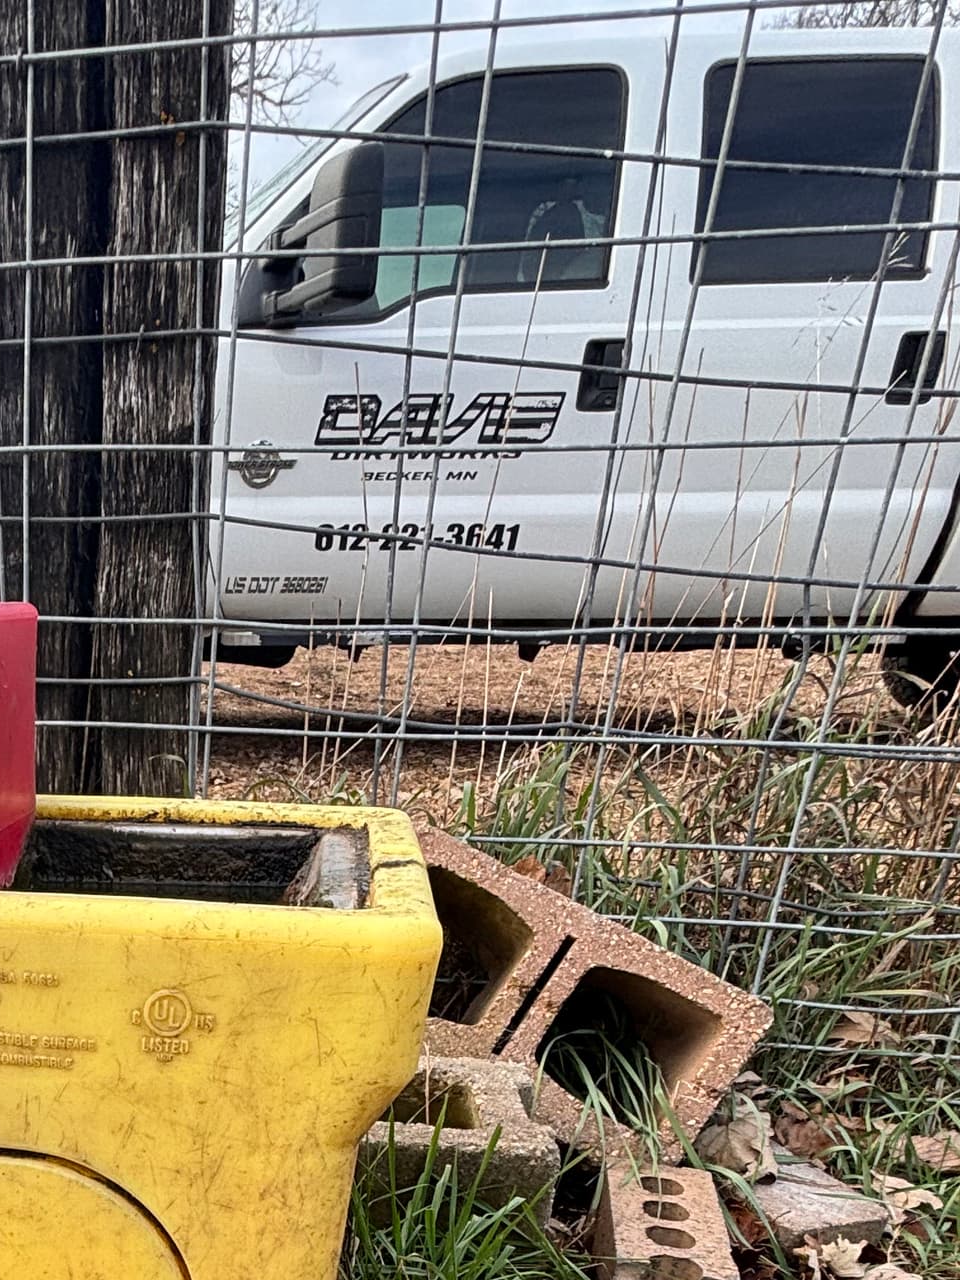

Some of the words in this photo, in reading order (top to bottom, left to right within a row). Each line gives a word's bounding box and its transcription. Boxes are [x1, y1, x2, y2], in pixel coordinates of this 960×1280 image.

[446, 470, 479, 481] MN
[225, 577, 247, 594] US
[248, 577, 280, 594] DOT
[154, 999, 182, 1028] UL
[40, 1036, 97, 1051] SURFACE
[142, 1036, 190, 1054] LISTED
